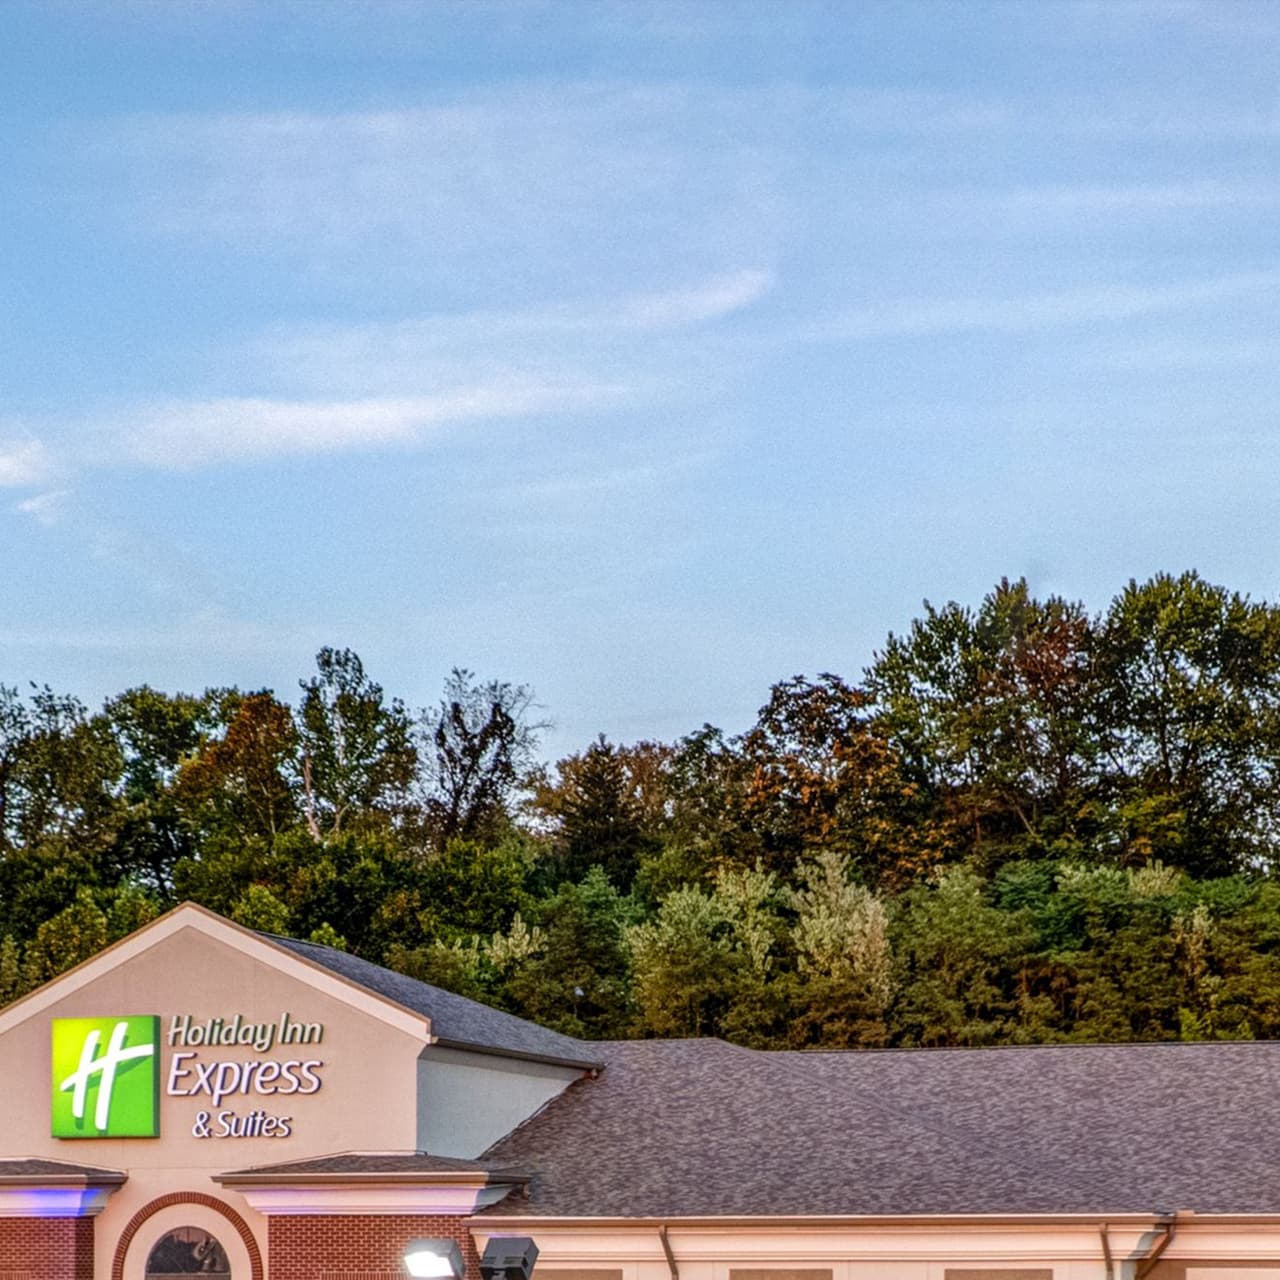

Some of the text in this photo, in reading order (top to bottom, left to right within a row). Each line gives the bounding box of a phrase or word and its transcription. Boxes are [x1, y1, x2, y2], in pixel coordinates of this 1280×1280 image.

[168, 1011, 323, 1050] Holiday Inn
[167, 1052, 322, 1107] Express
[192, 1109, 292, 1138] & Suites
